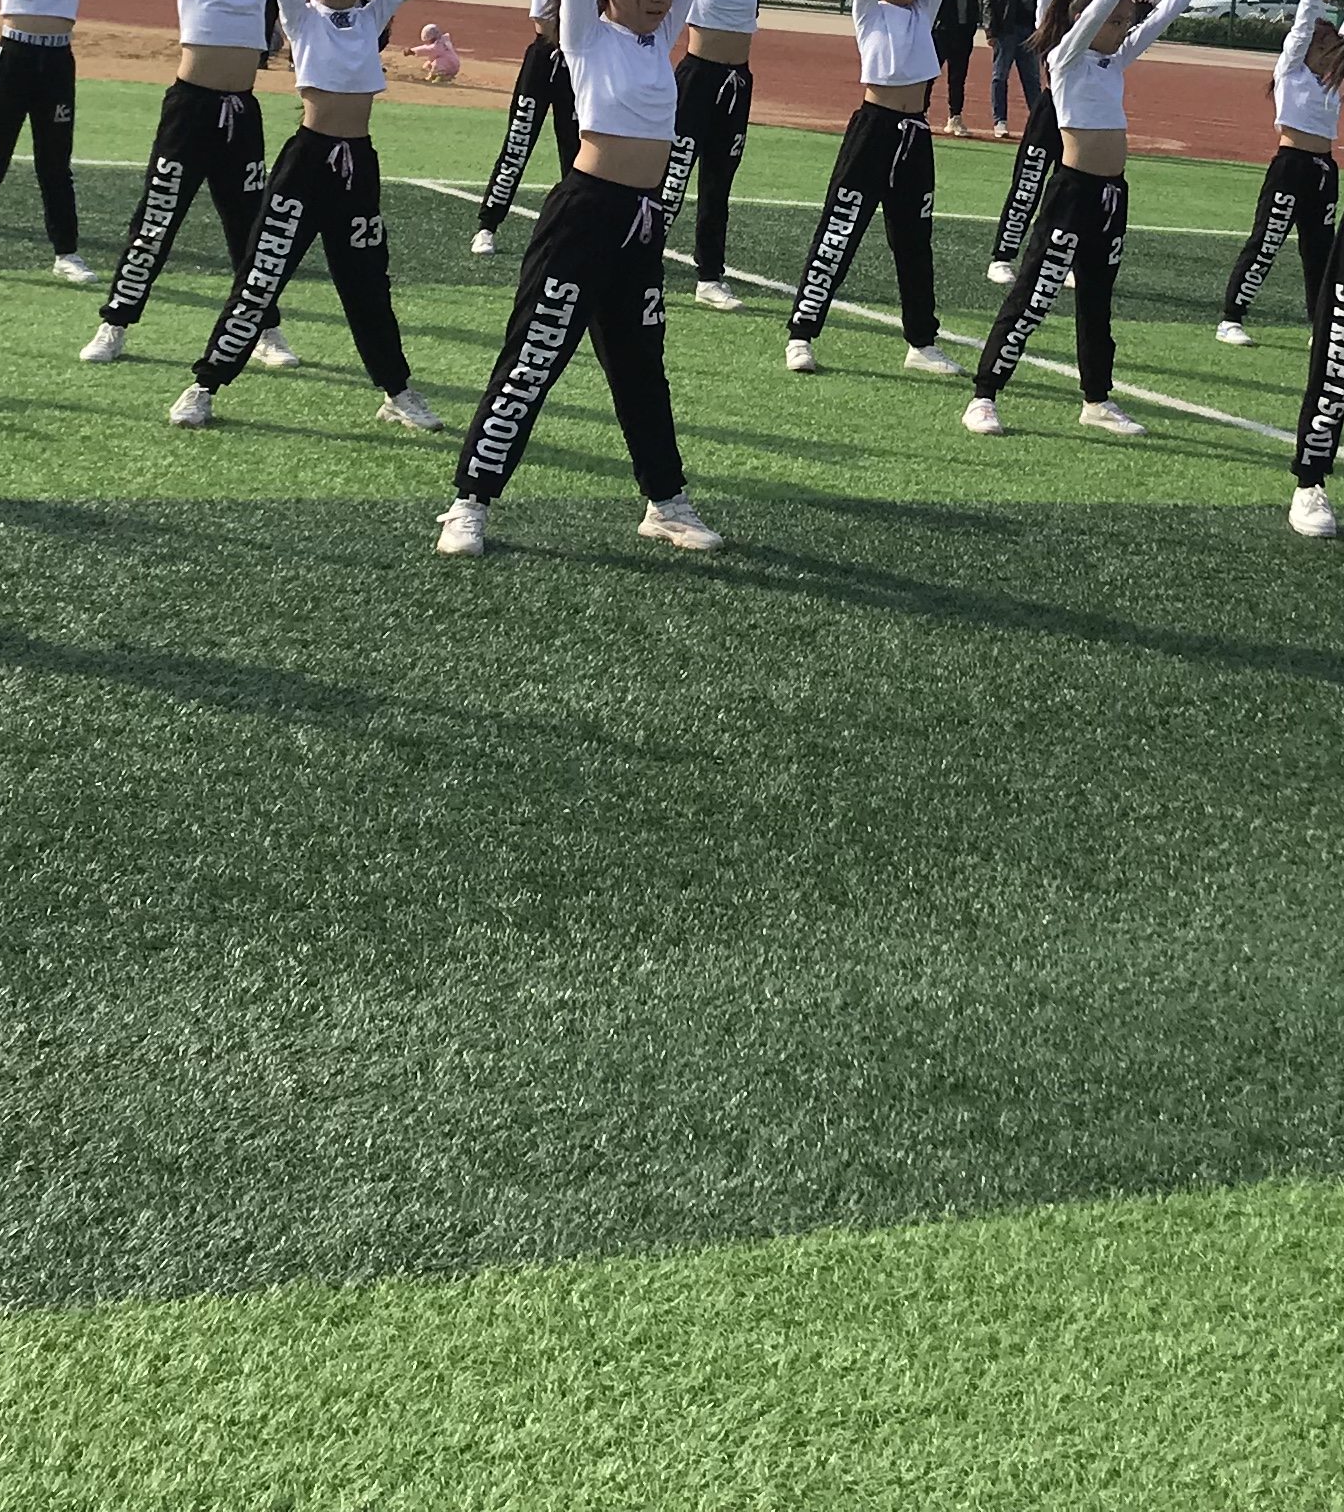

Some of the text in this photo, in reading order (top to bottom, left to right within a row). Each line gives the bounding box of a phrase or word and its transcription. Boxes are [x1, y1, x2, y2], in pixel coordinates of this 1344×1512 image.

[487, 95, 536, 208] STREETSOUL
[998, 145, 1047, 254] STREETSOUL
[108, 157, 183, 309] STREETSOUL
[208, 193, 303, 365] STREETSOUL
[351, 216, 382, 248] 23
[793, 188, 863, 324] STREETSOUL
[1235, 192, 1296, 308] STREETSOUL
[993, 229, 1078, 377] STREETSOUL
[467, 276, 579, 479] STREETSOUL
